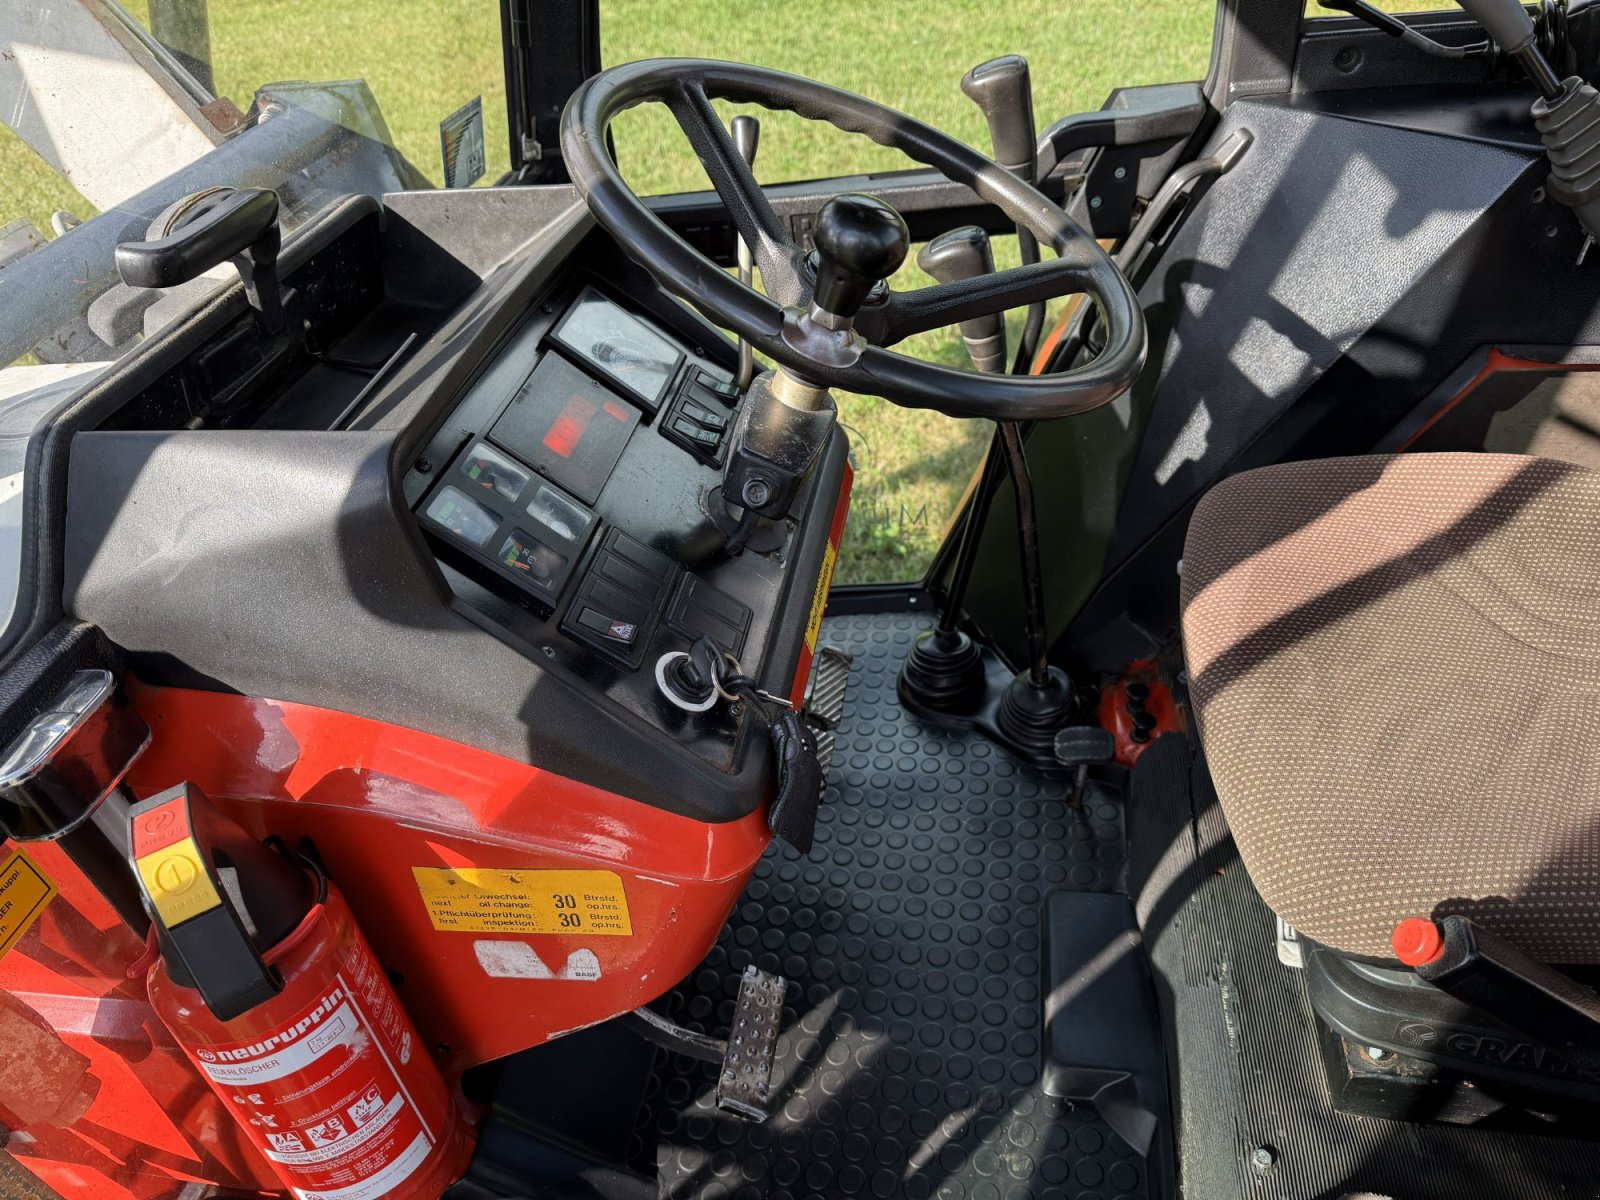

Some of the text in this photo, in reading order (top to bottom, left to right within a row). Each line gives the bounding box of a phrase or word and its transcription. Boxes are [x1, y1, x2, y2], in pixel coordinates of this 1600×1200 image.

[0, 870, 22, 896] kuppl.
[552, 894, 577, 909] 30
[558, 913, 581, 927] 30
[217, 988, 344, 1061] neuruppin
[207, 1059, 280, 1077] FEUERLÖSCHER
[283, 1075, 331, 1101] Sicherungstaste
[286, 1088, 378, 1142] A B C
[298, 1107, 331, 1124] Drucktaste
[331, 1090, 357, 1110] betätigen
